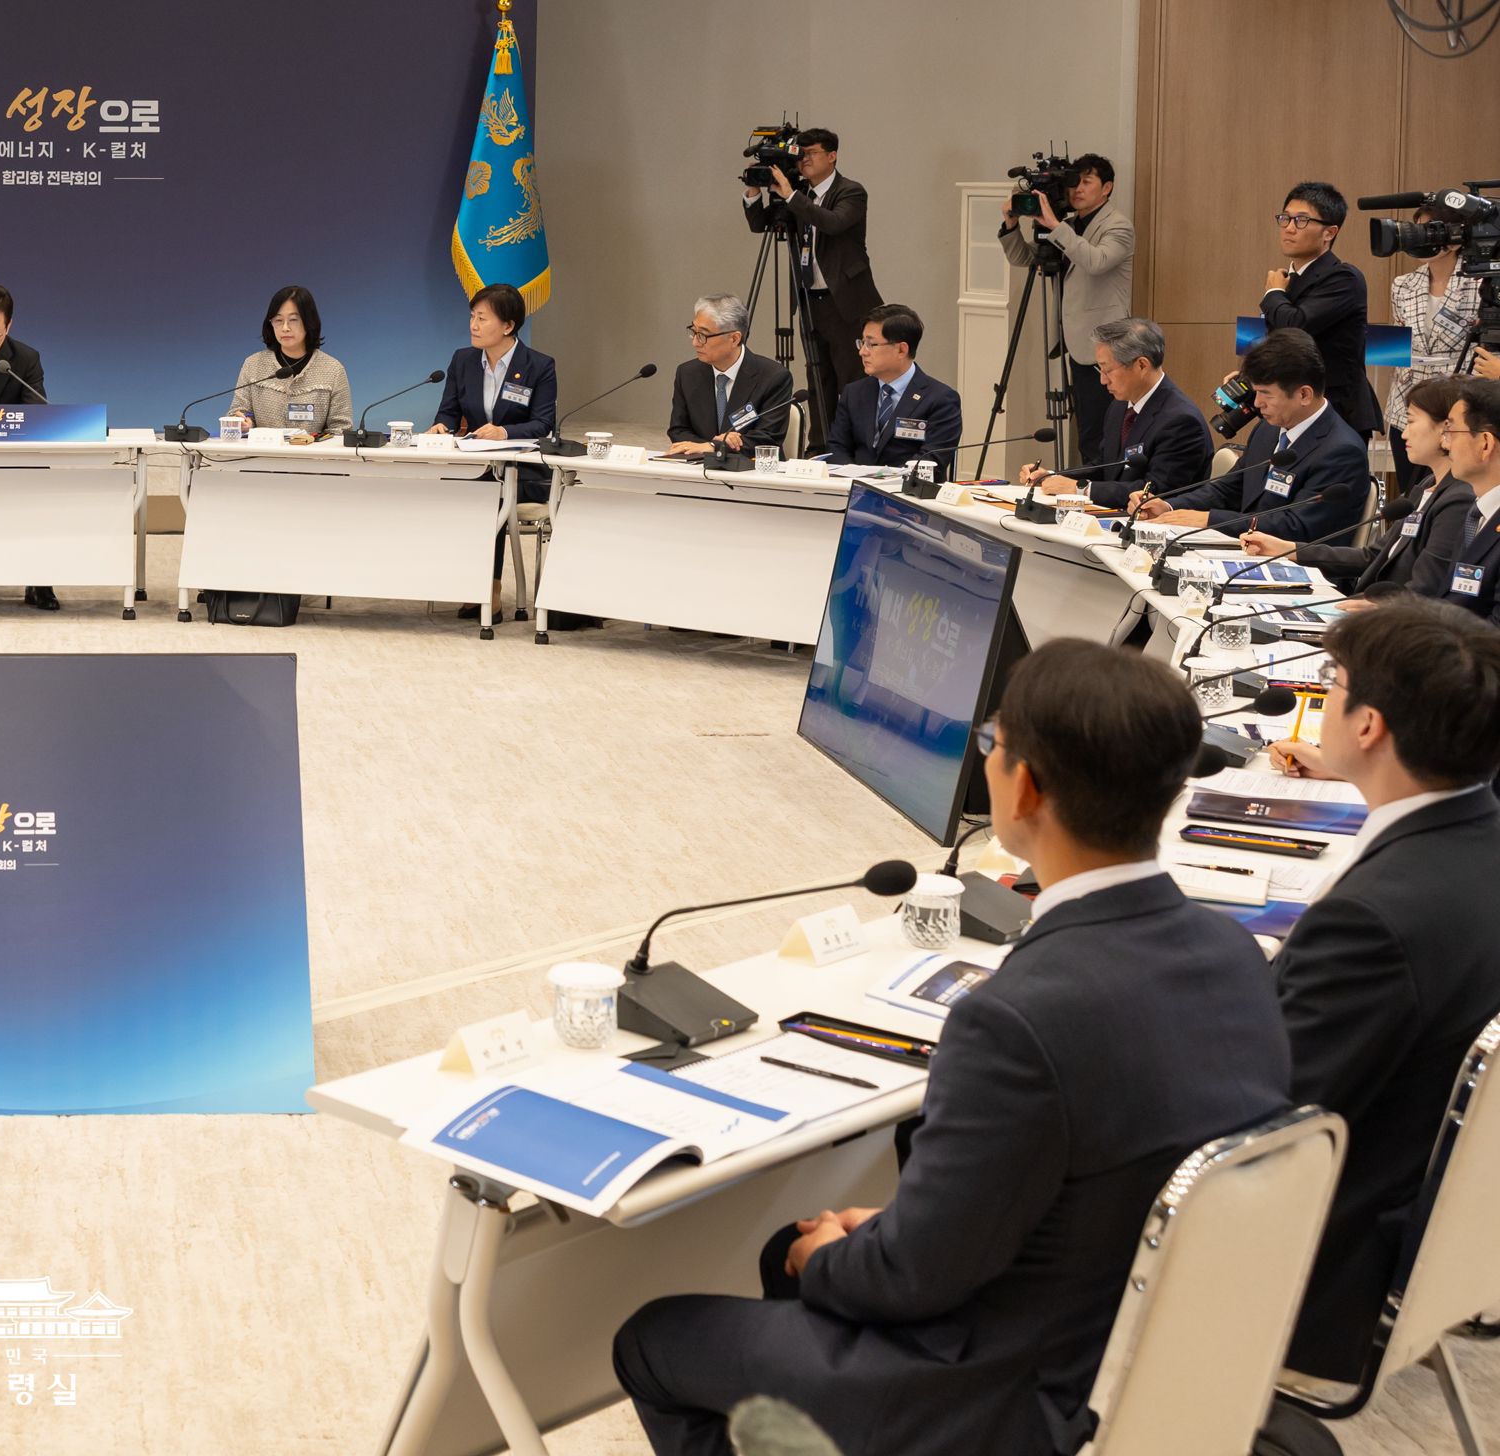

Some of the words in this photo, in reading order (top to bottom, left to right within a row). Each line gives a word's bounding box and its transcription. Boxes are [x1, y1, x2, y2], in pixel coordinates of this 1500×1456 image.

[6, 86, 160, 133] 성장으로
[83, 141, 147, 160] K-컬처
[2, 170, 44, 187] 합리화
[47, 170, 102, 187] 전략회의
[1446, 195, 1465, 206] KTV
[3, 840, 47, 852] K-컬처
